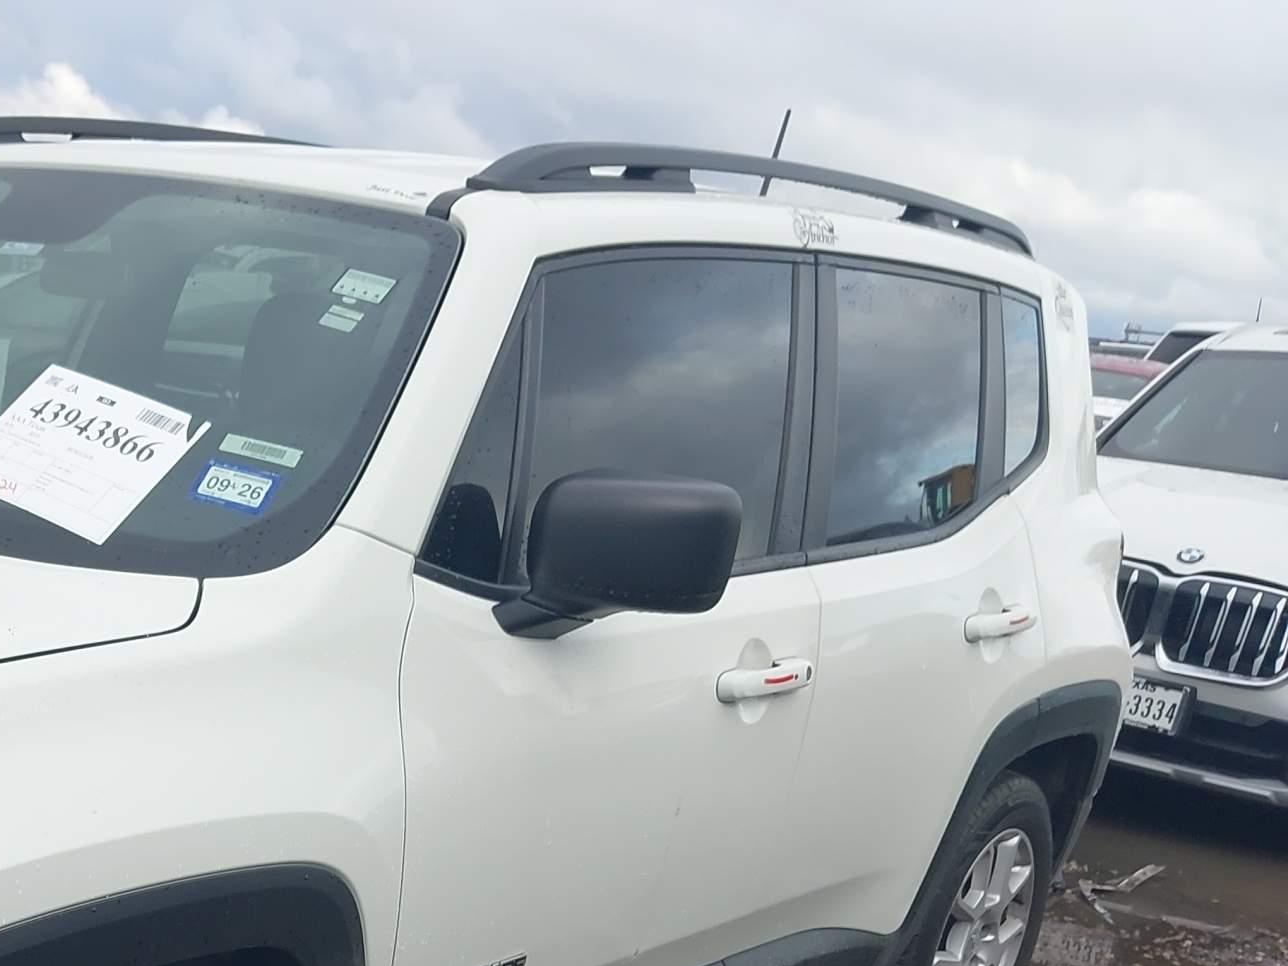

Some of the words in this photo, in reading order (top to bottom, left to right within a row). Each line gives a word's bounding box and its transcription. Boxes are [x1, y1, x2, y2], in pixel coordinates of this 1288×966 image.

[29, 398, 164, 462] 43943866
[206, 475, 231, 492] 09
[237, 483, 264, 500] 26
